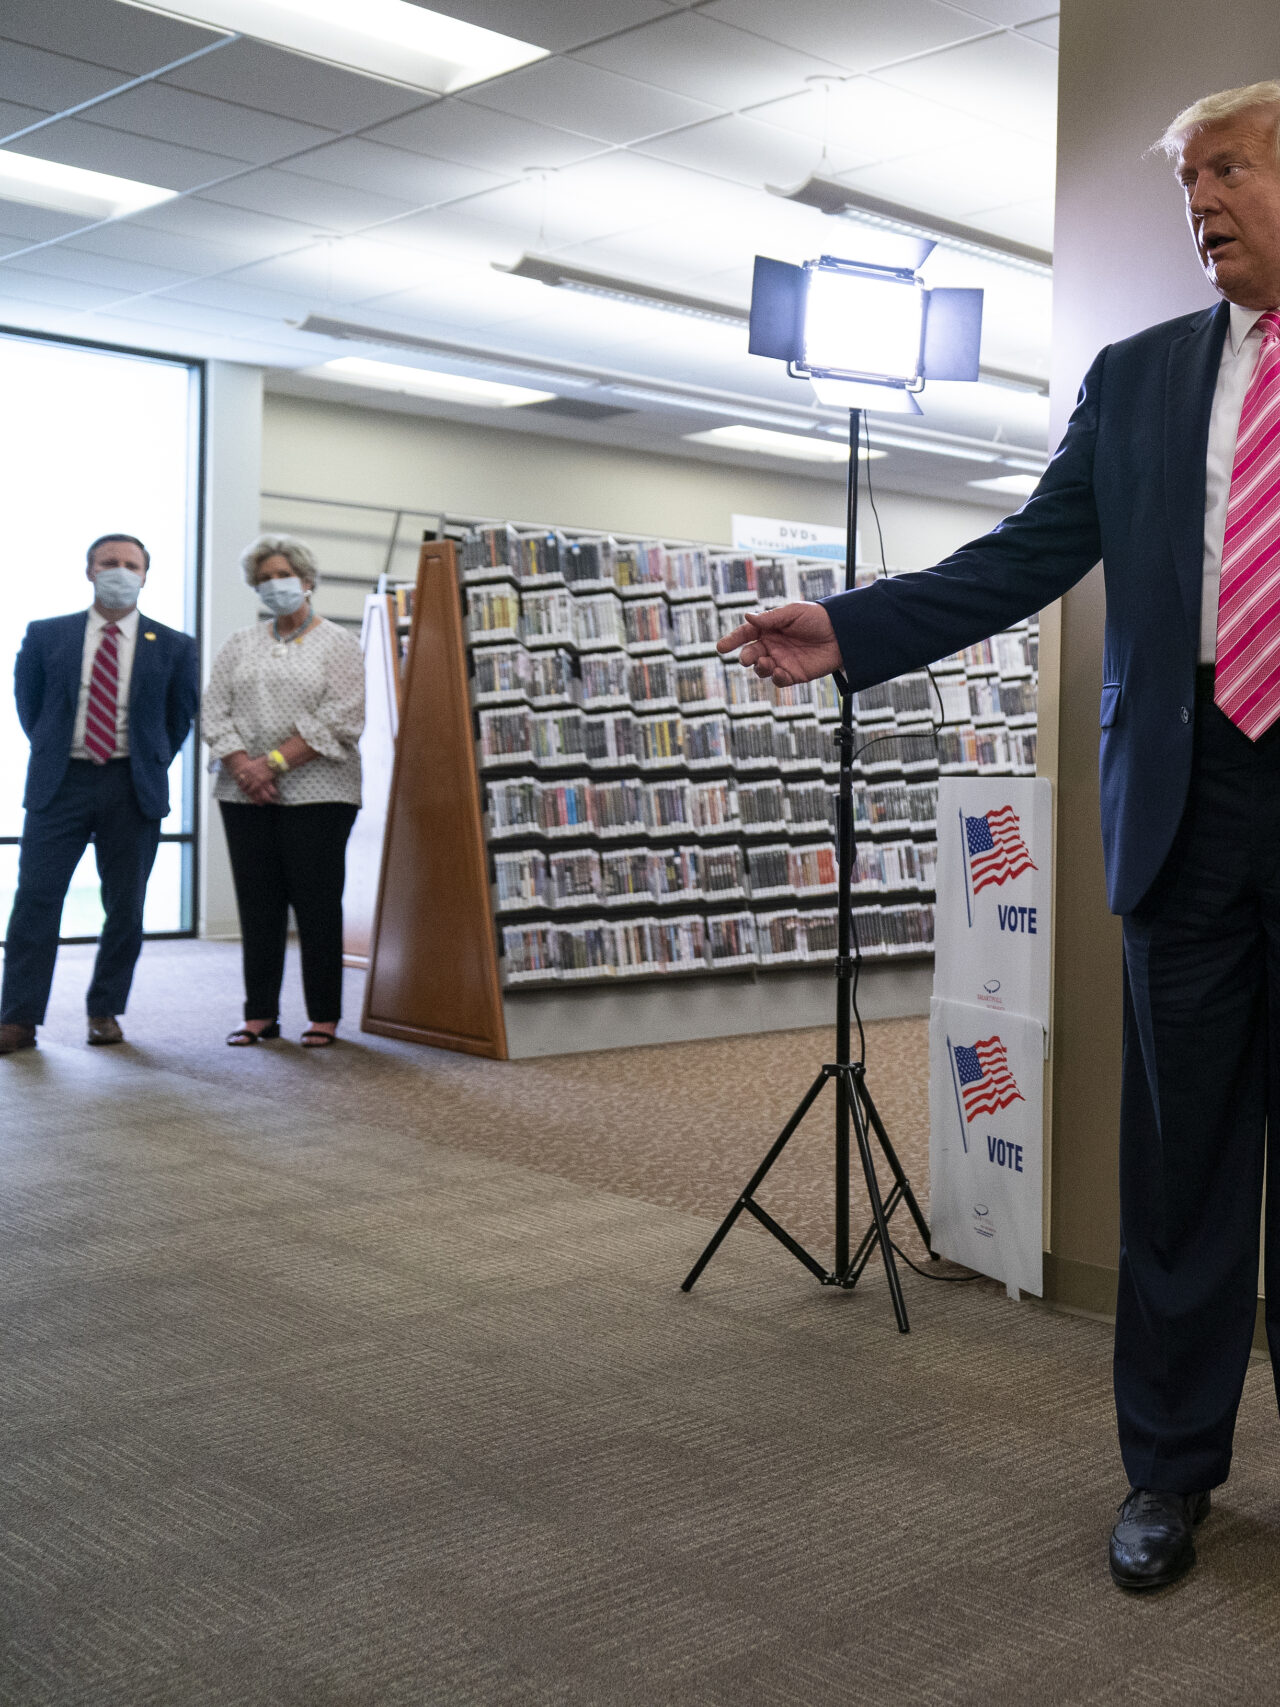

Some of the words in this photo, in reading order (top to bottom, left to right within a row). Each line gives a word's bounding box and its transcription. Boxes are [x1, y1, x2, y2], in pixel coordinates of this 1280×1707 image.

[779, 526, 817, 541] DVDs
[998, 904, 1037, 934] VOTE
[987, 1135, 1023, 1173] VOTE
